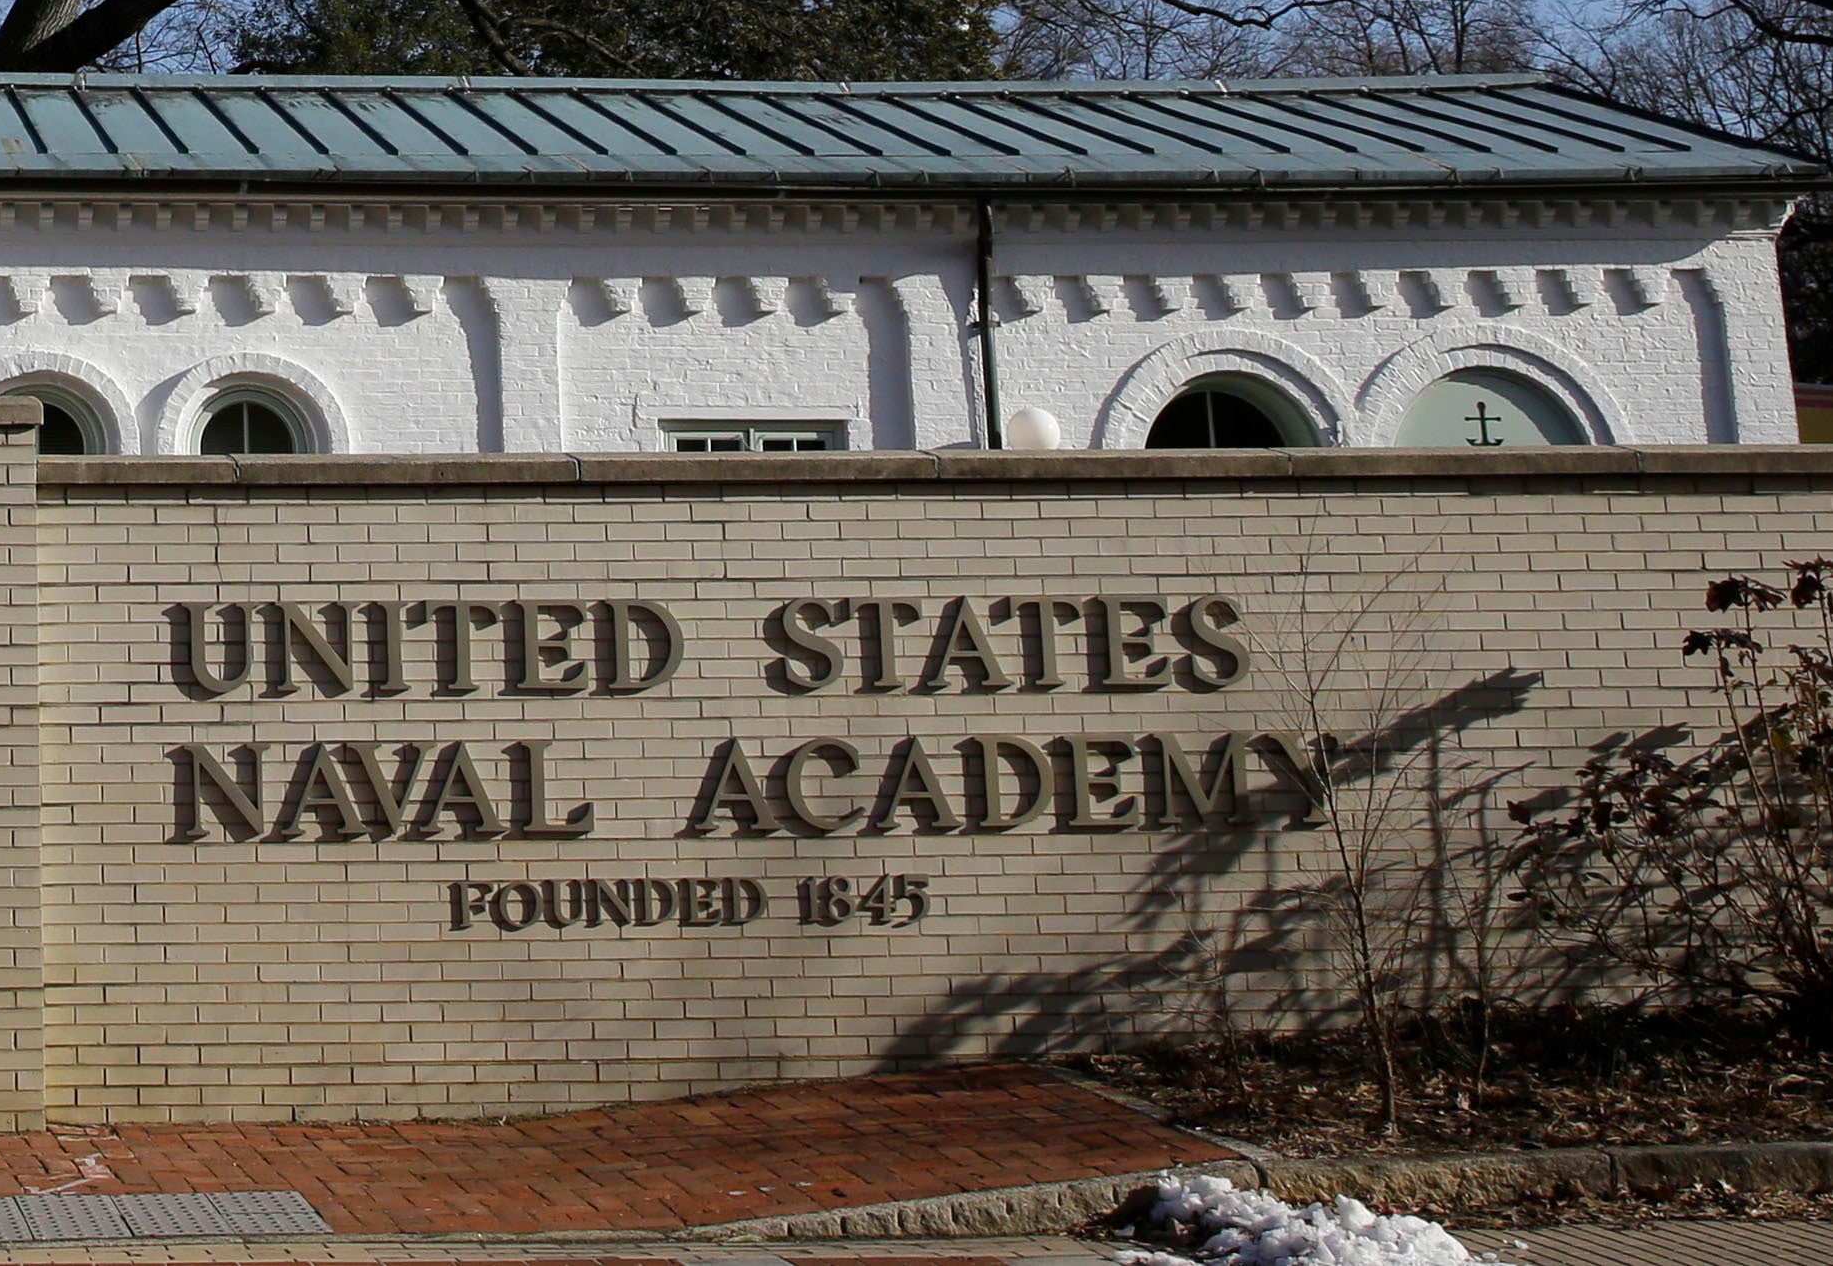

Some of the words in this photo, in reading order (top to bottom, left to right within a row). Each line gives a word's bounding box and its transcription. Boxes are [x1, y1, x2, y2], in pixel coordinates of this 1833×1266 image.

[179, 599, 685, 696] UNITED
[779, 595, 1251, 691] STATES
[177, 740, 595, 838] NAVAL
[689, 734, 1339, 832] ACADEMY
[455, 877, 767, 930] FOUNDED
[799, 873, 931, 928] 1845
